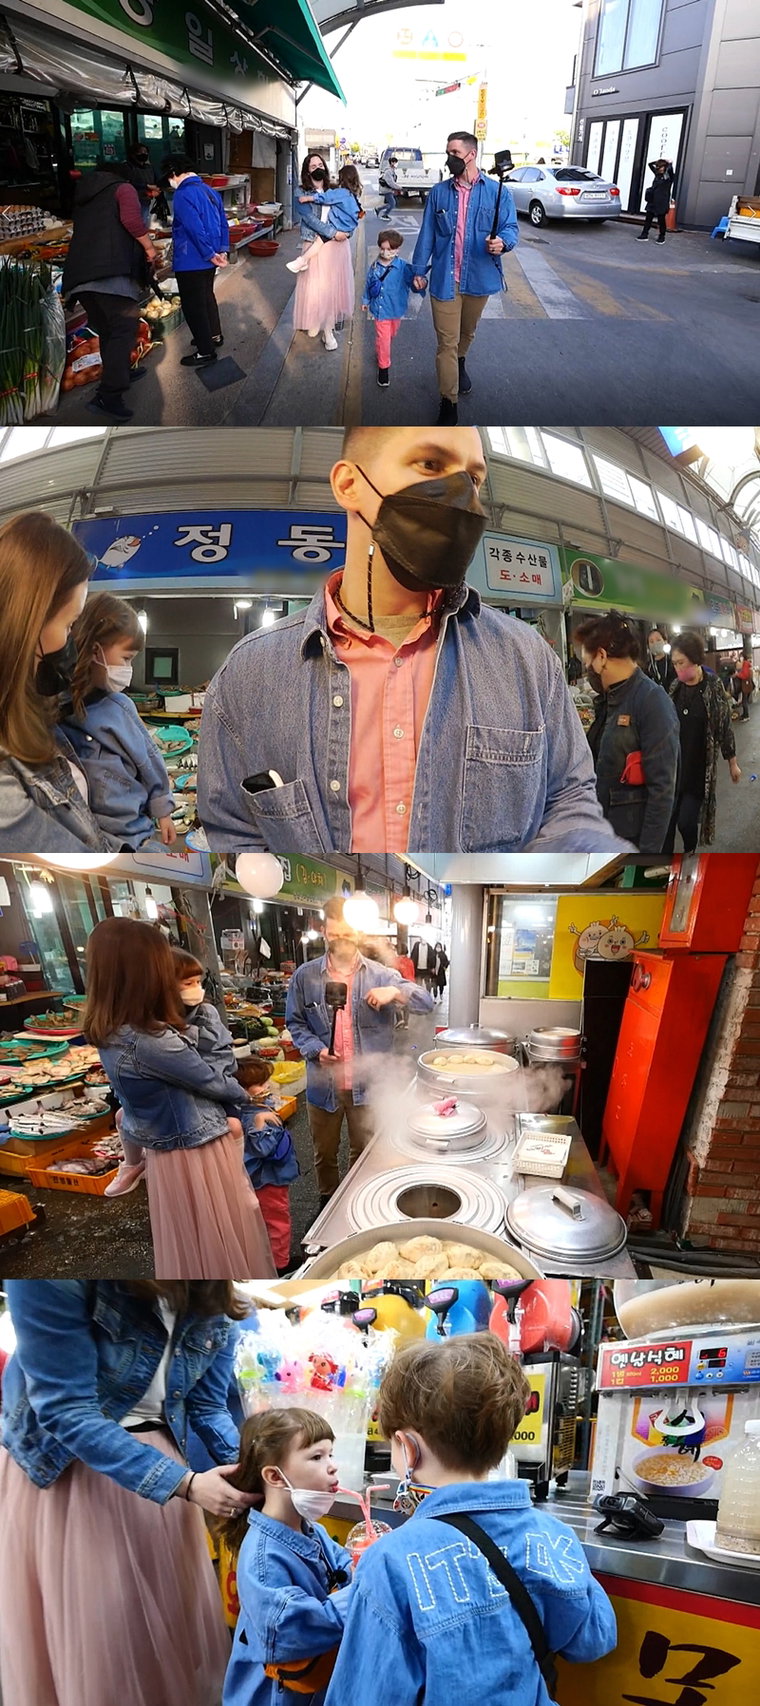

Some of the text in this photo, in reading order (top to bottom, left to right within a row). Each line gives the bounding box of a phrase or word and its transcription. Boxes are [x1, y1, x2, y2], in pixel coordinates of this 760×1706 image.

[488, 547, 548, 569] 각종 수산물
[499, 569, 542, 586] 도·소매
[718, 1347, 727, 1358] 6
[514, 1431, 535, 1441] 000
[525, 1531, 585, 1584] OK
